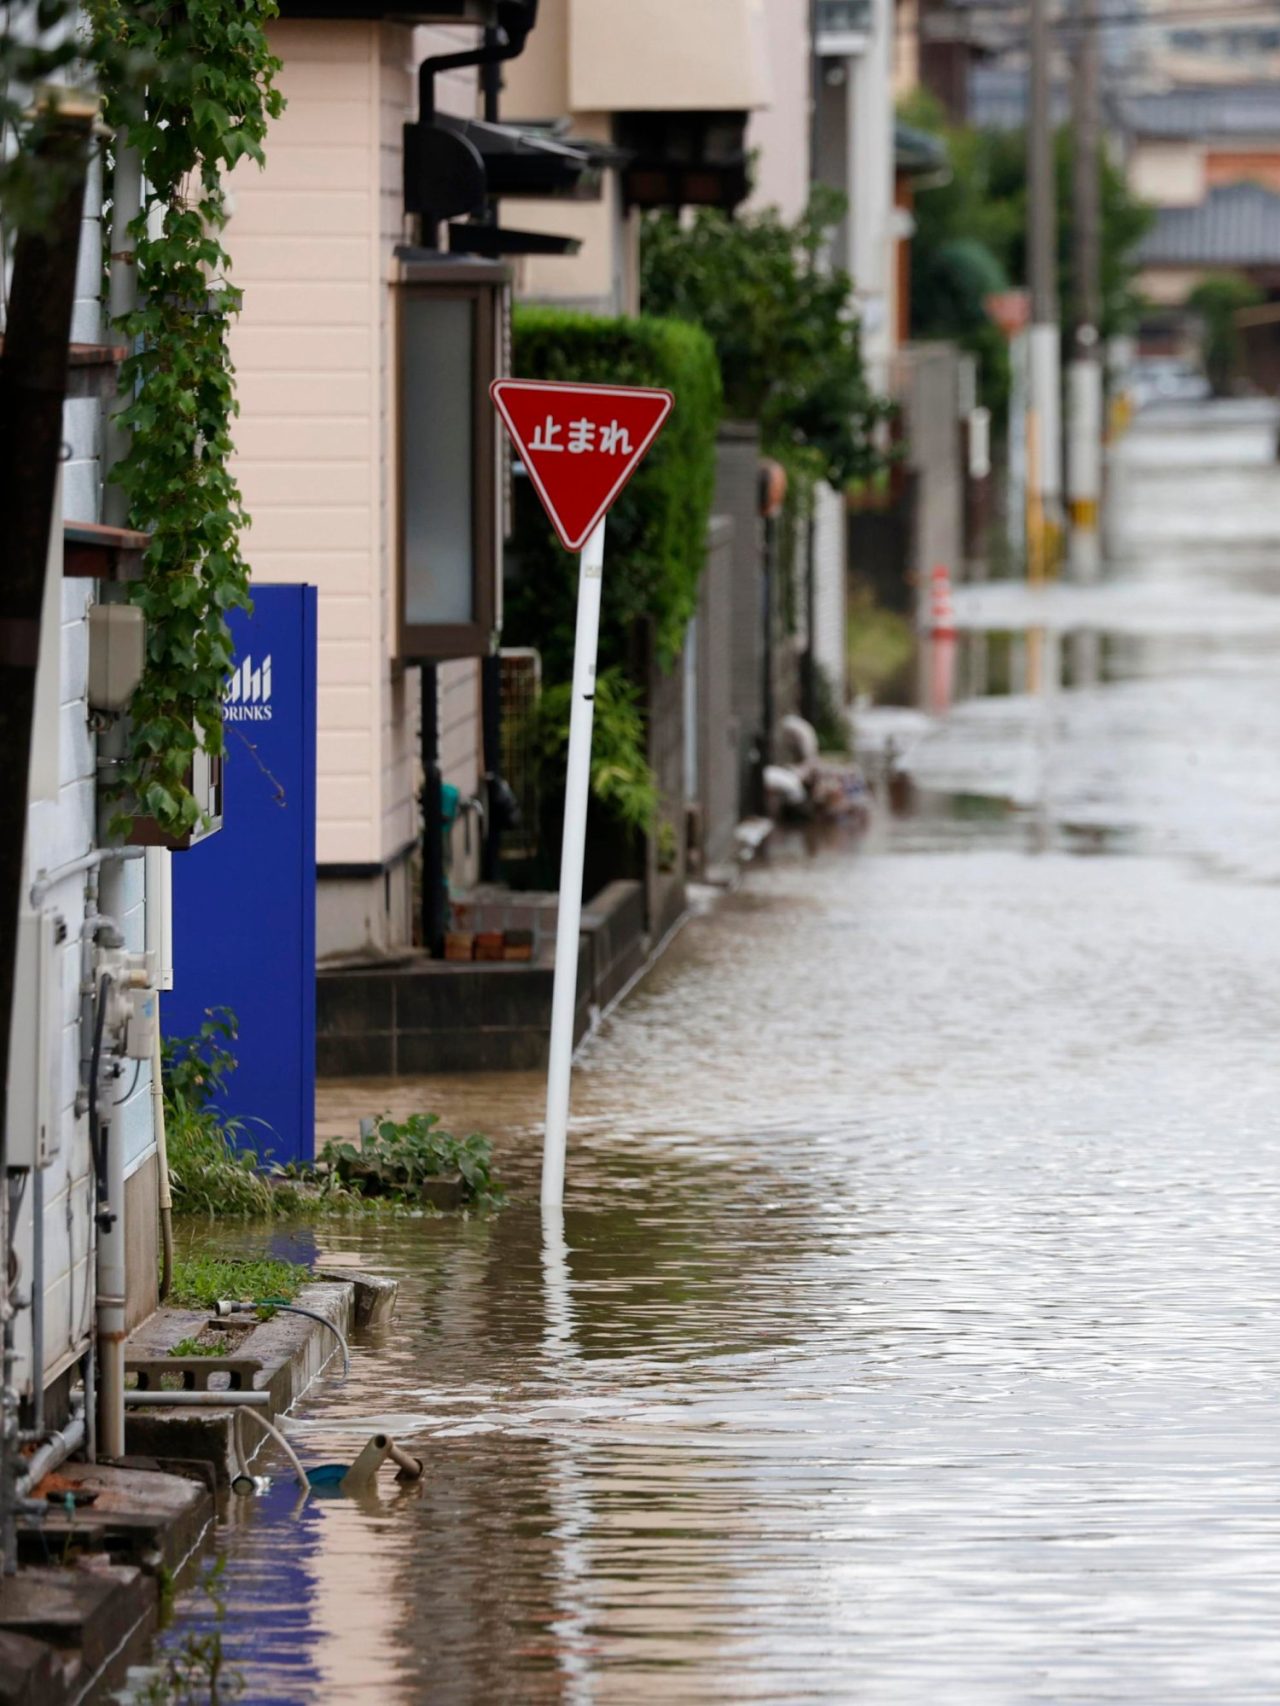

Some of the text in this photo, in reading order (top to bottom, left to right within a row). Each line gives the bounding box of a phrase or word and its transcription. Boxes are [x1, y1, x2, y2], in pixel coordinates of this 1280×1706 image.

[528, 414, 634, 456] 止まれ
[222, 653, 272, 704] ahi
